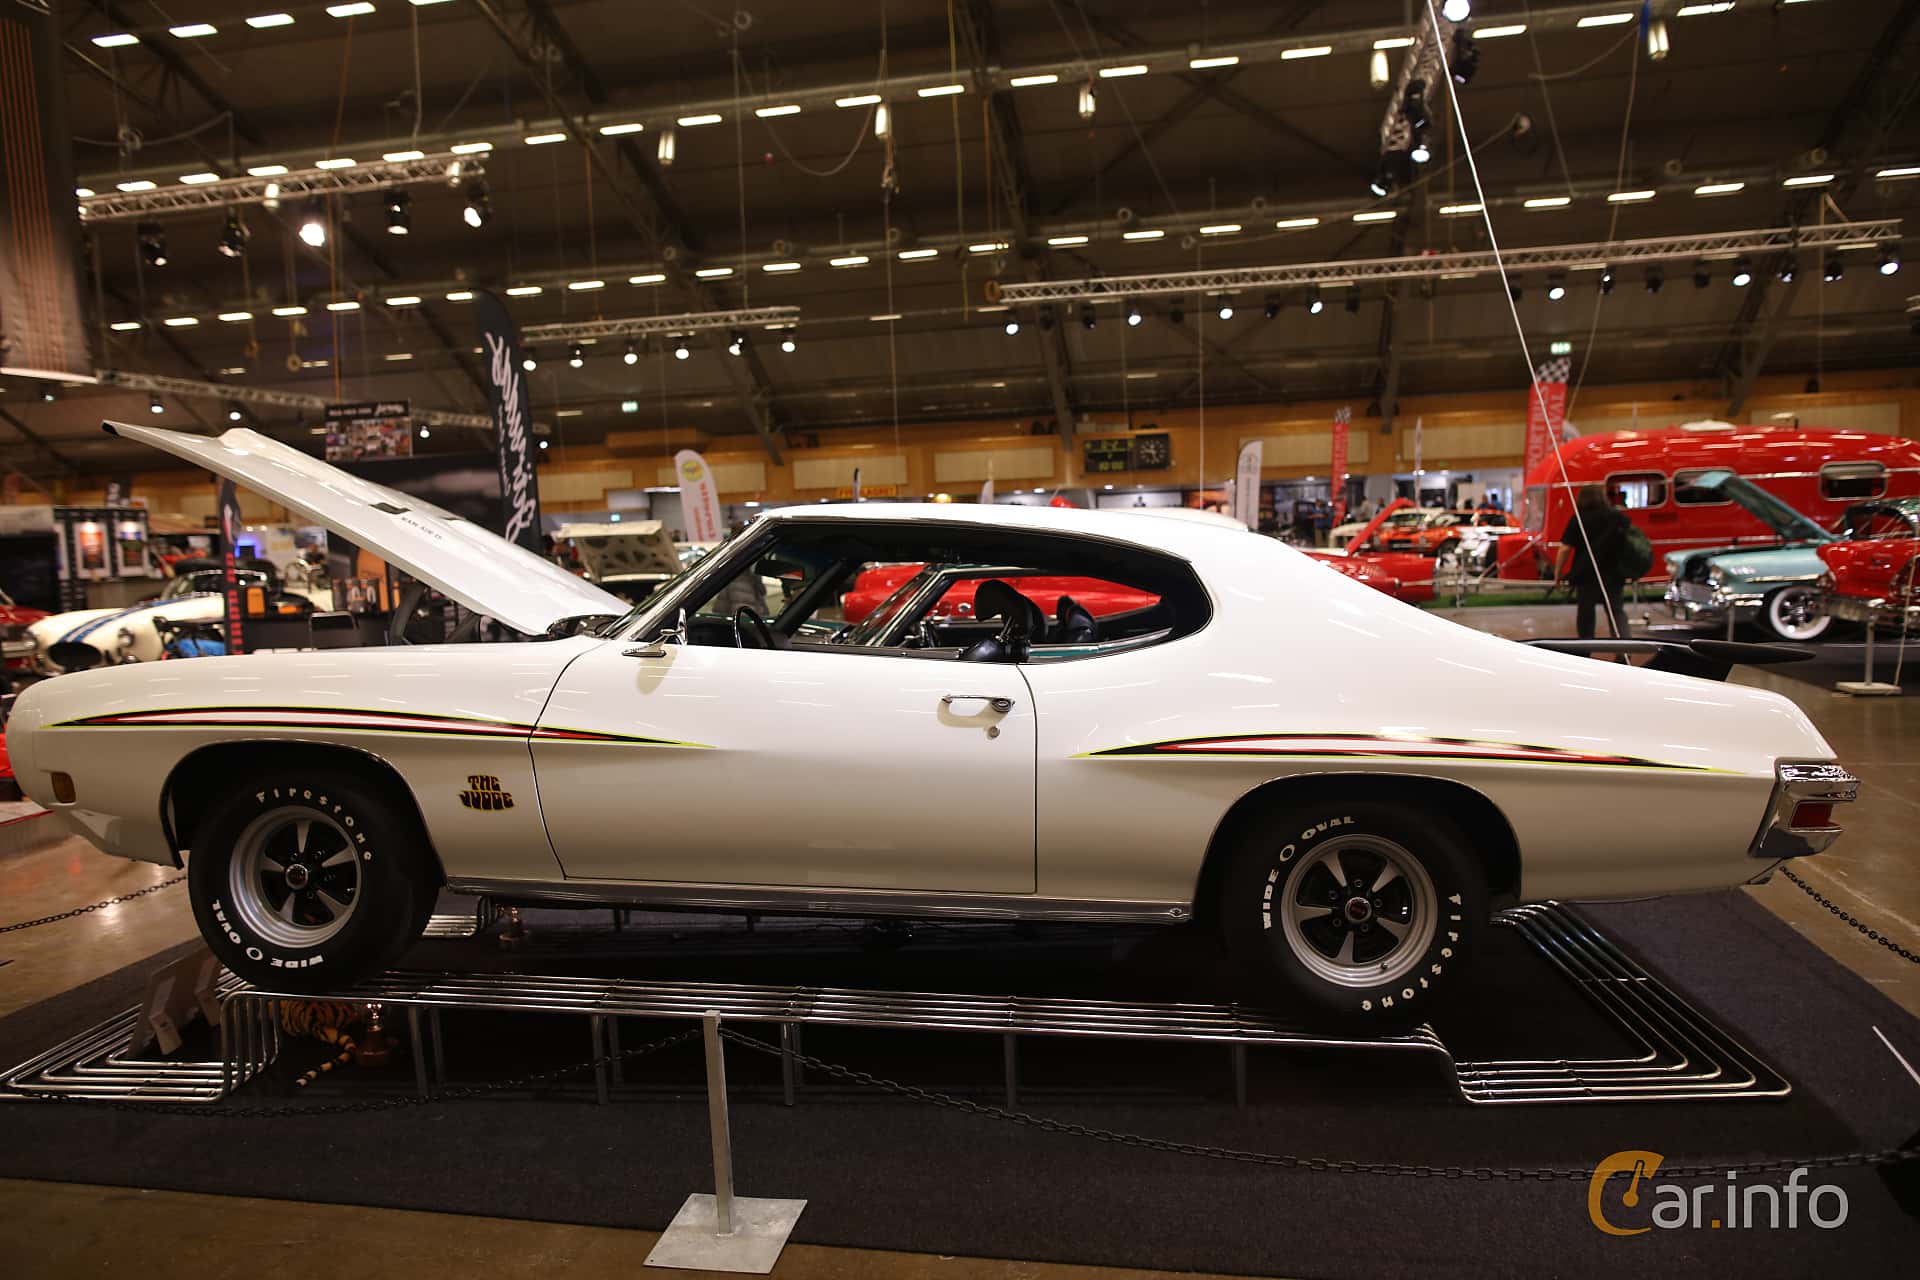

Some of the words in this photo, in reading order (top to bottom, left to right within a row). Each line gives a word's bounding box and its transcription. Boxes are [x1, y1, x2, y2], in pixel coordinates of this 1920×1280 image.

[467, 775, 501, 791] THE
[458, 791, 515, 811] JUDGE
[1262, 869, 1280, 930] WIDE
[1301, 816, 1356, 840] OVAL
[211, 899, 242, 945] OVAL
[270, 953, 325, 969] WIDE
